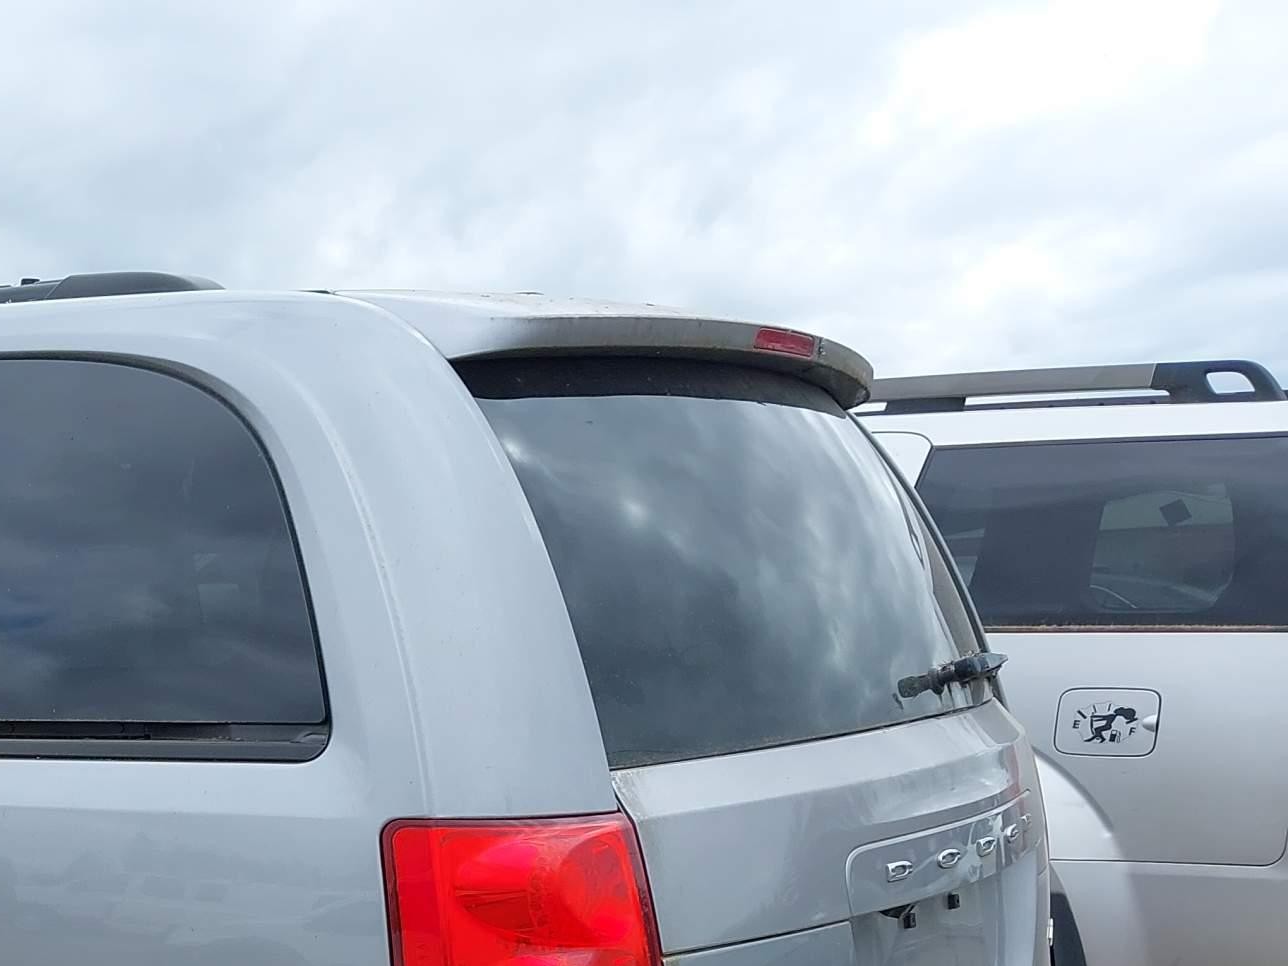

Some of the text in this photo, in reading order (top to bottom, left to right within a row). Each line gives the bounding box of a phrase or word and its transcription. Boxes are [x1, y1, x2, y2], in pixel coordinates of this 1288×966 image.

[1072, 720, 1081, 730] E
[1129, 727, 1137, 736] F
[885, 813, 1032, 882] DODGE
